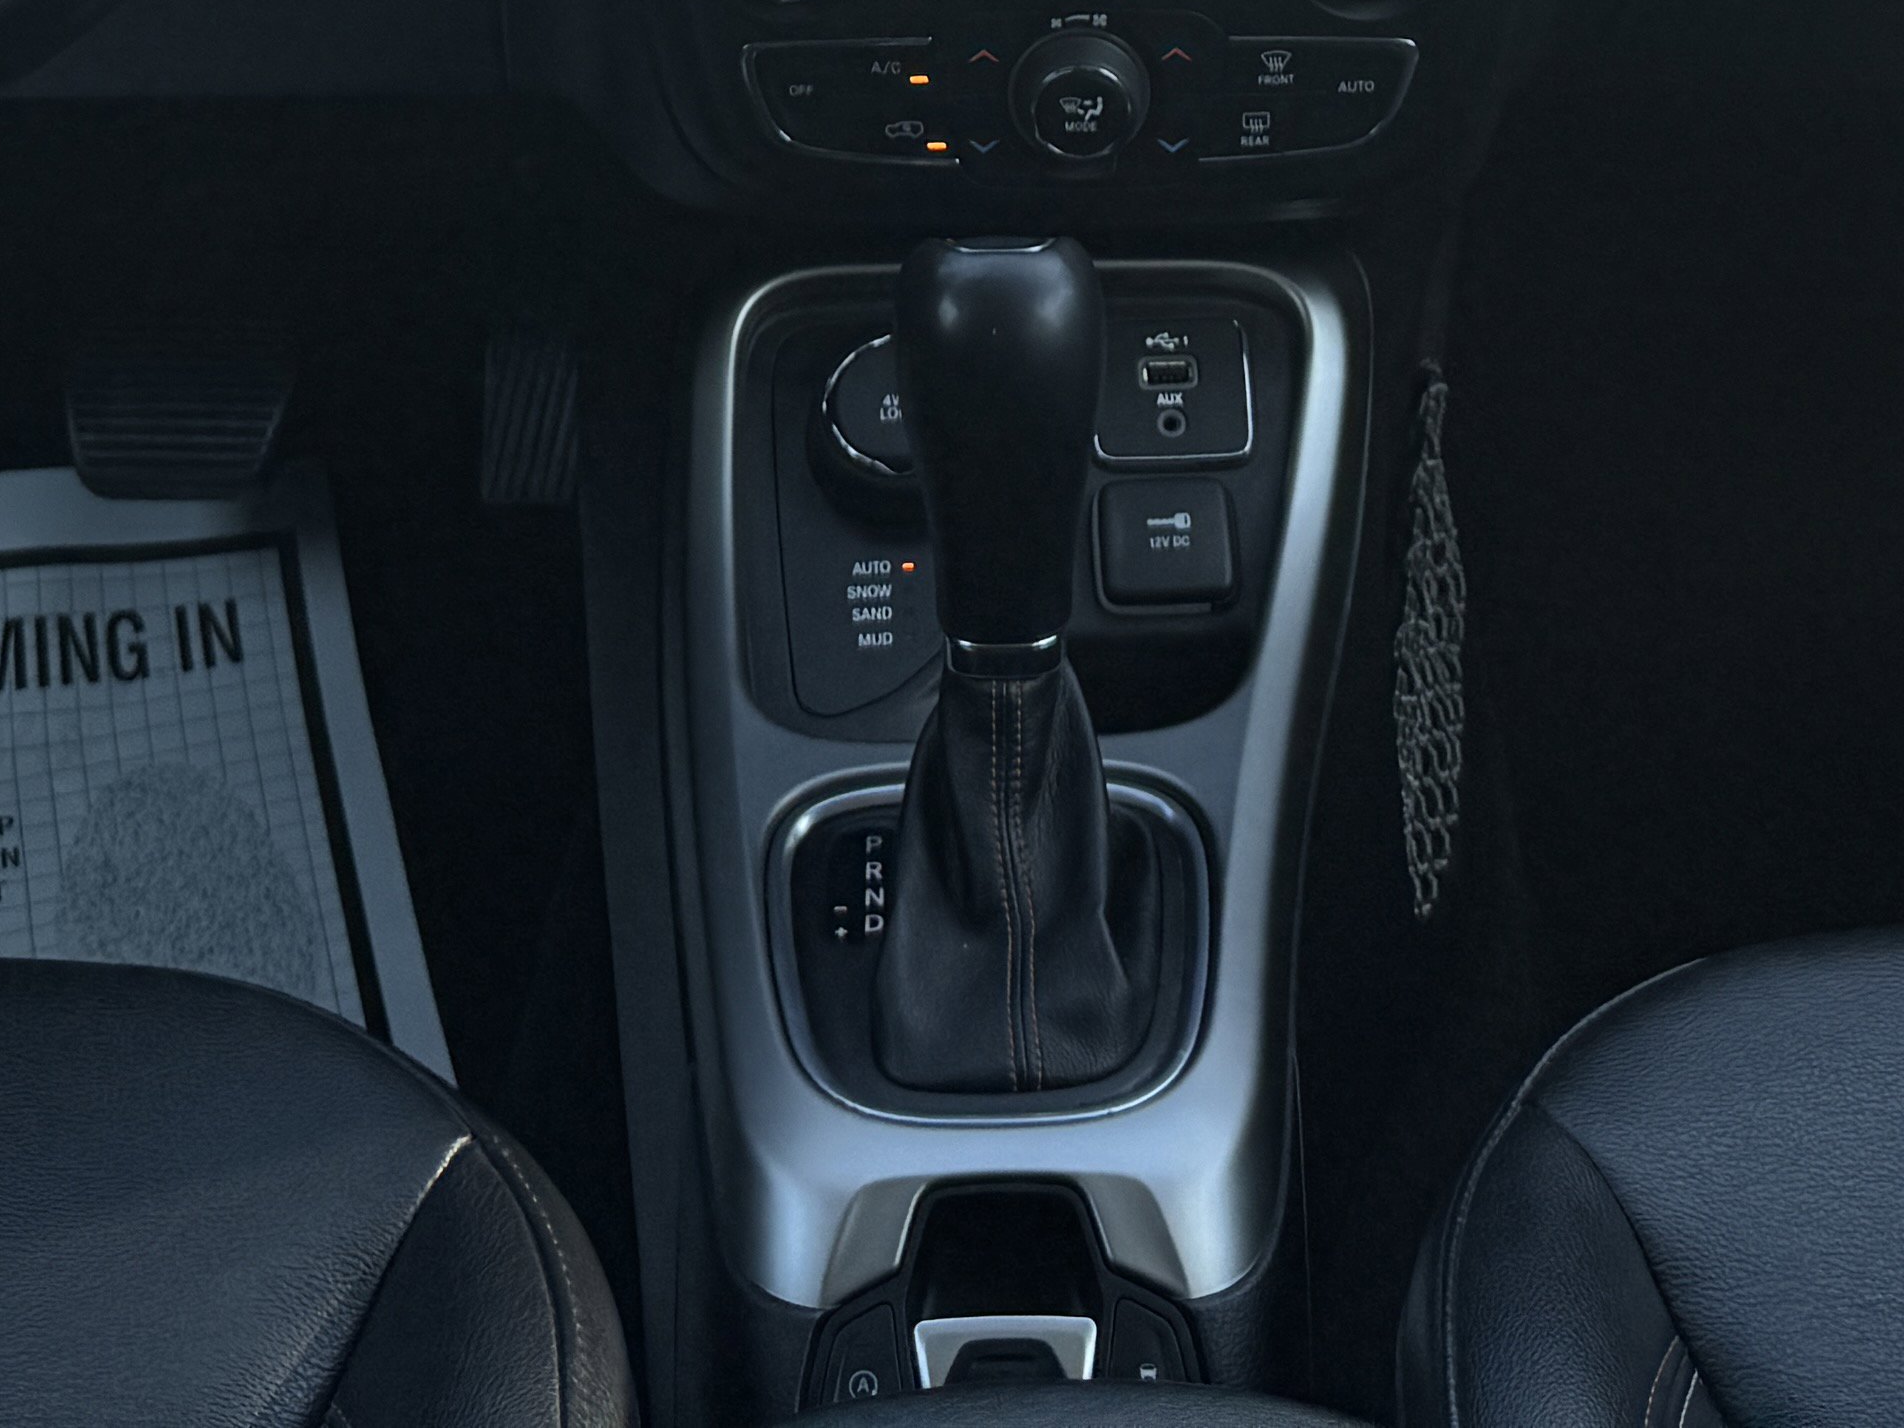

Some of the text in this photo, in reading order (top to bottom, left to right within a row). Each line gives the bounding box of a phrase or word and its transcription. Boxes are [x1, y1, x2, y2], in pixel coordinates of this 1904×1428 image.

[871, 62, 902, 74] A/C
[1257, 74, 1294, 86] FRONT
[789, 85, 813, 97] OFF
[1338, 81, 1375, 93] AUTO
[1064, 121, 1097, 133] MODE
[1240, 136, 1270, 147] REAR
[1156, 392, 1184, 405] AUX
[1150, 535, 1191, 549] 12V DC
[852, 561, 891, 575] AUTO
[847, 585, 893, 598] SNOW
[852, 608, 893, 621] SAND
[176, 598, 248, 668] IN
[858, 632, 894, 646] MUD
[865, 835, 882, 854] P
[865, 861, 883, 879] R
[865, 887, 885, 906] N
[865, 914, 884, 933] D
